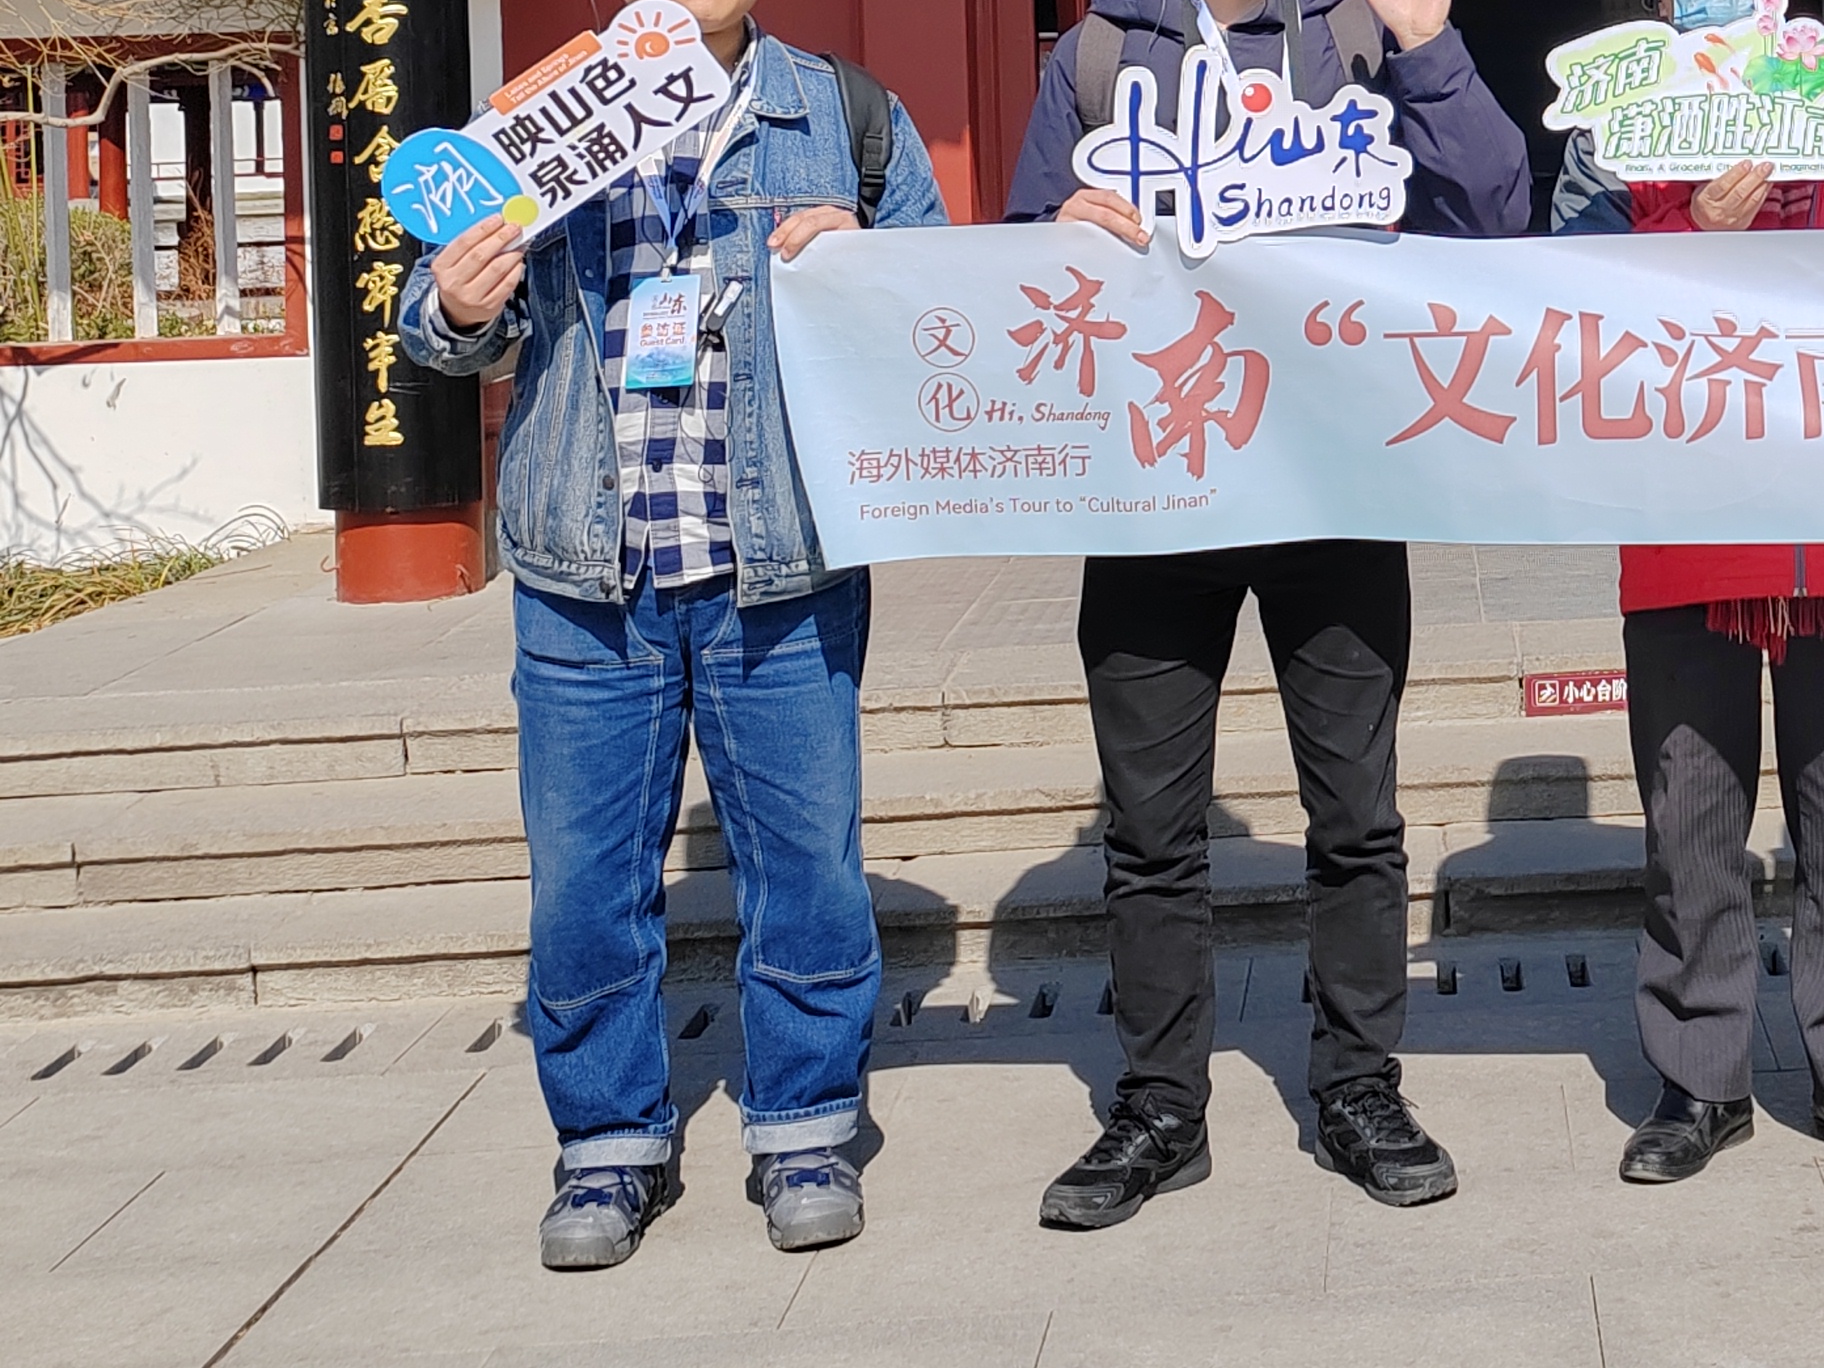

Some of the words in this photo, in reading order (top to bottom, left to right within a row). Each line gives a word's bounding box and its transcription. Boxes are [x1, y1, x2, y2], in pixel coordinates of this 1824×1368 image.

[1561, 39, 1666, 114] 济南
[492, 56, 637, 166] 映山色
[528, 66, 715, 209] 泉涌人文
[1212, 183, 1392, 226] Shandong
[984, 401, 1025, 425] Hi,
[1031, 401, 1111, 431] Shandong
[847, 442, 1092, 486] 海外媒体济南行
[859, 501, 930, 521] Foreign
[1009, 497, 1050, 514] Tour
[1054, 498, 1074, 514] to
[1562, 678, 1627, 704] 小心台阶
